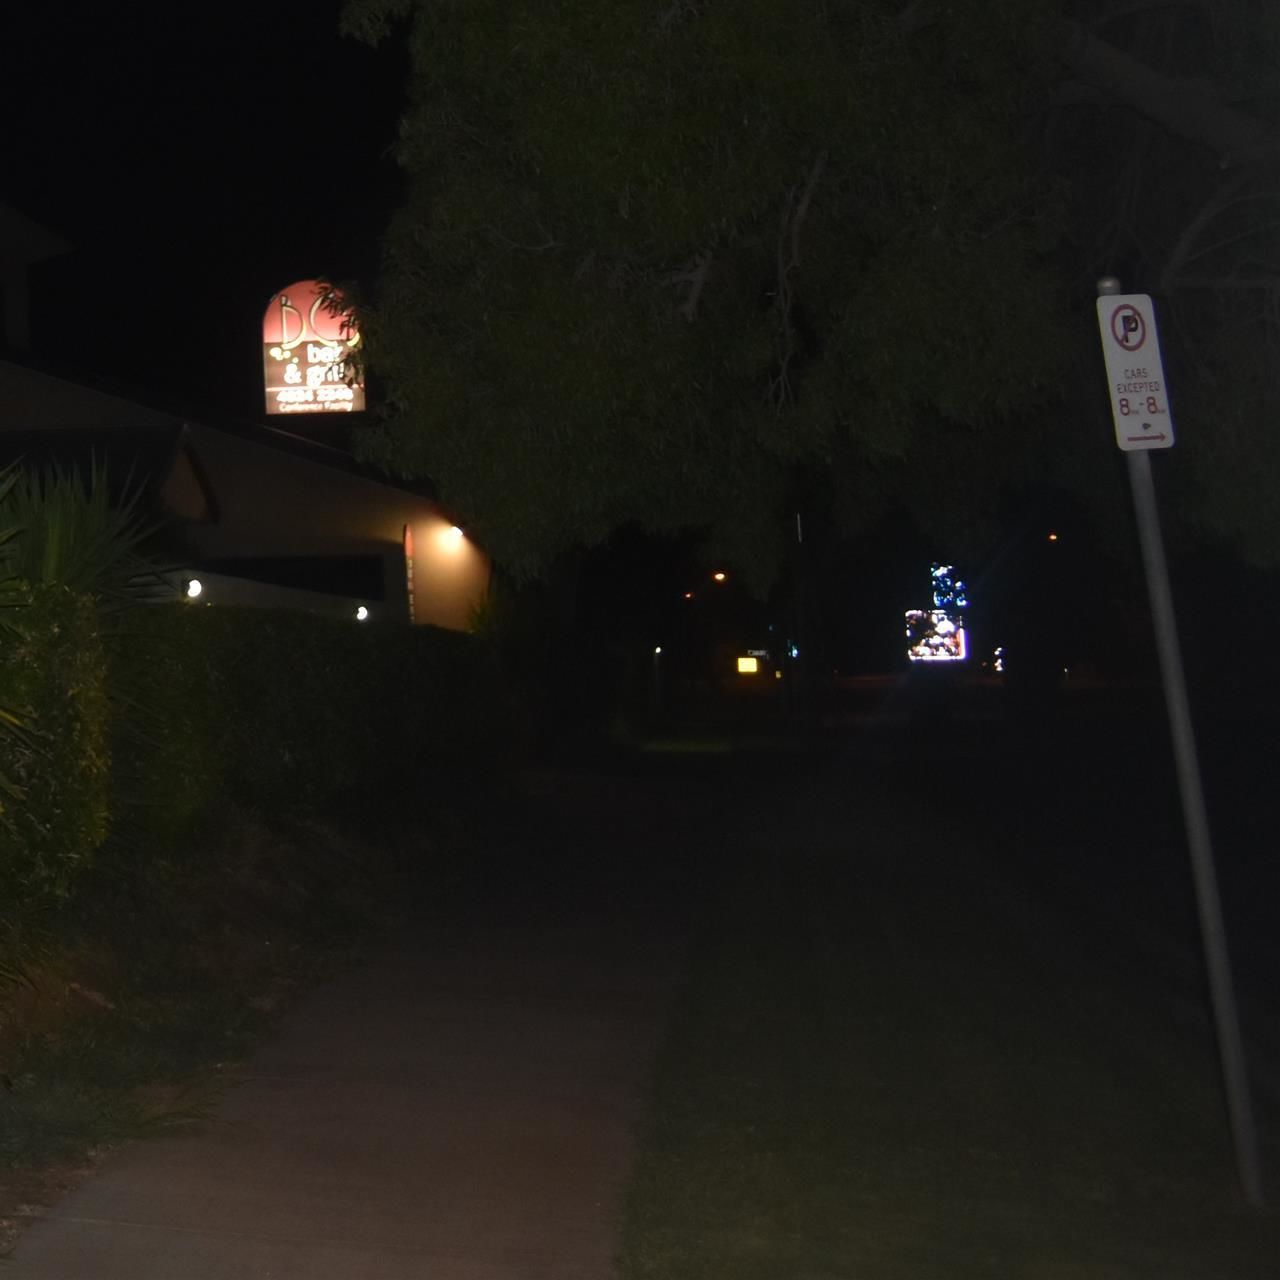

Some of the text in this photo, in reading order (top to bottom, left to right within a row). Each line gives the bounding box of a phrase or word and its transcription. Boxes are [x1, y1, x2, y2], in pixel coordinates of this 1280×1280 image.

[284, 363, 302, 384] &
[1124, 368, 1149, 380] CARS
[1117, 381, 1161, 394] EXCEPTED
